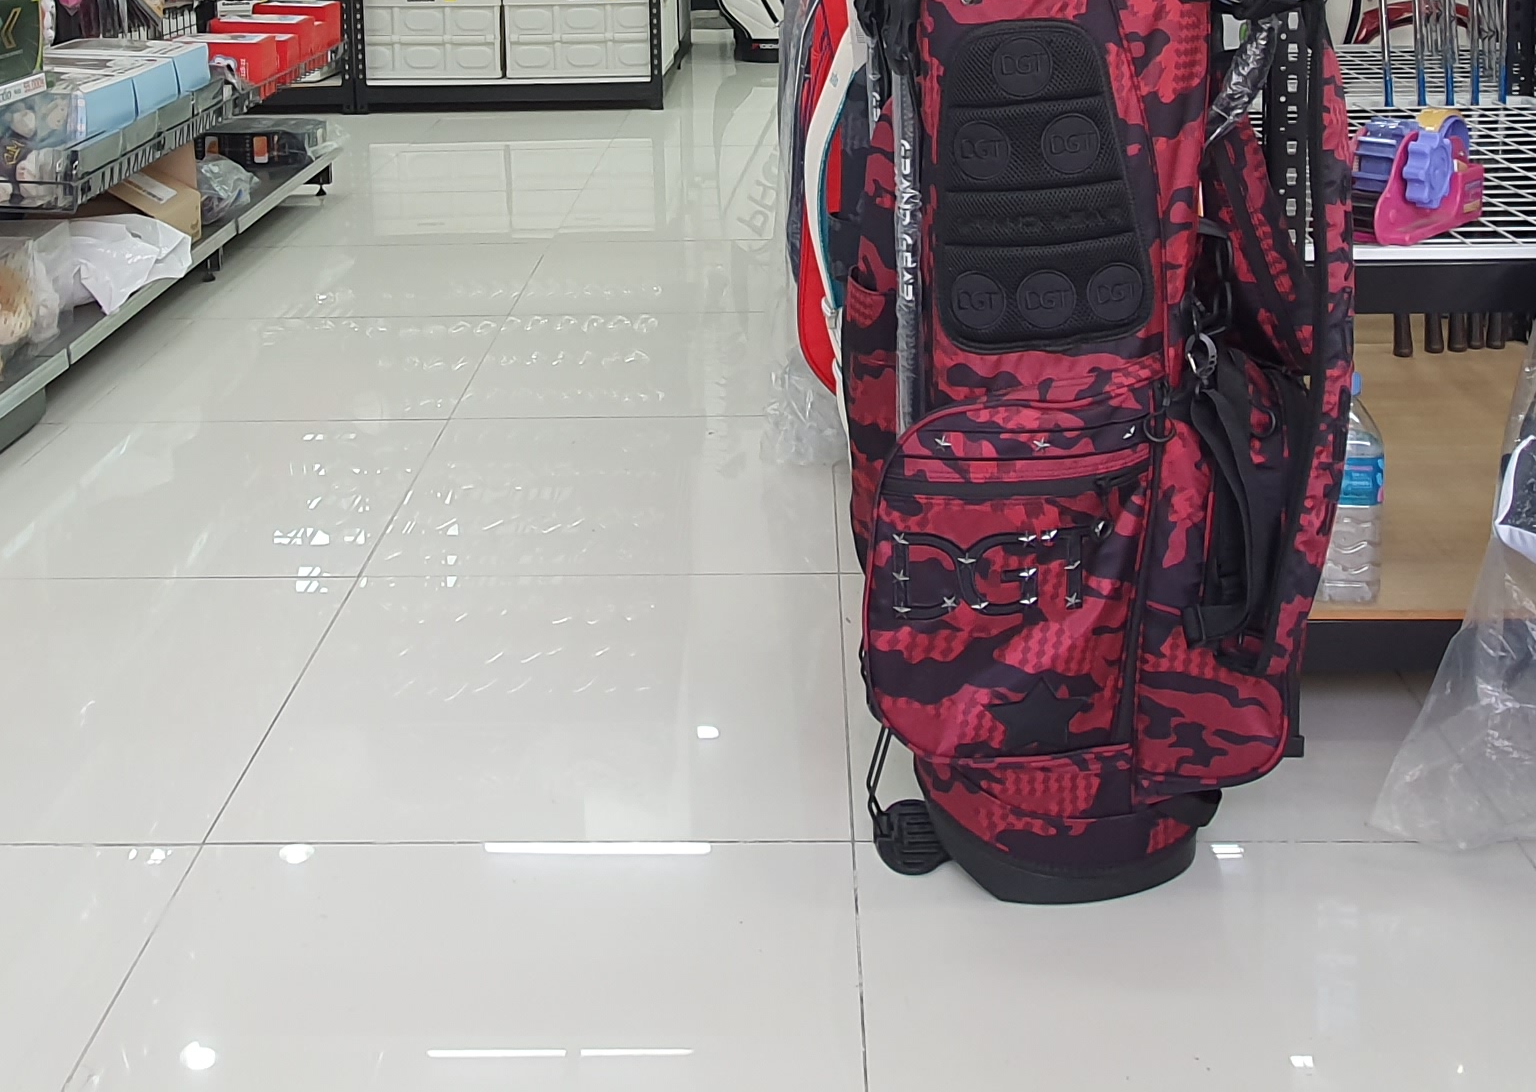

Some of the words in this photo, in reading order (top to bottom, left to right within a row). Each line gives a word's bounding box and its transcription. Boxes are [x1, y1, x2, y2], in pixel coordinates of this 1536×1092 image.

[1000, 53, 1045, 77] DGT
[1049, 130, 1095, 155] DGT
[1025, 289, 1070, 311] DGT
[891, 531, 1092, 619] DGT
